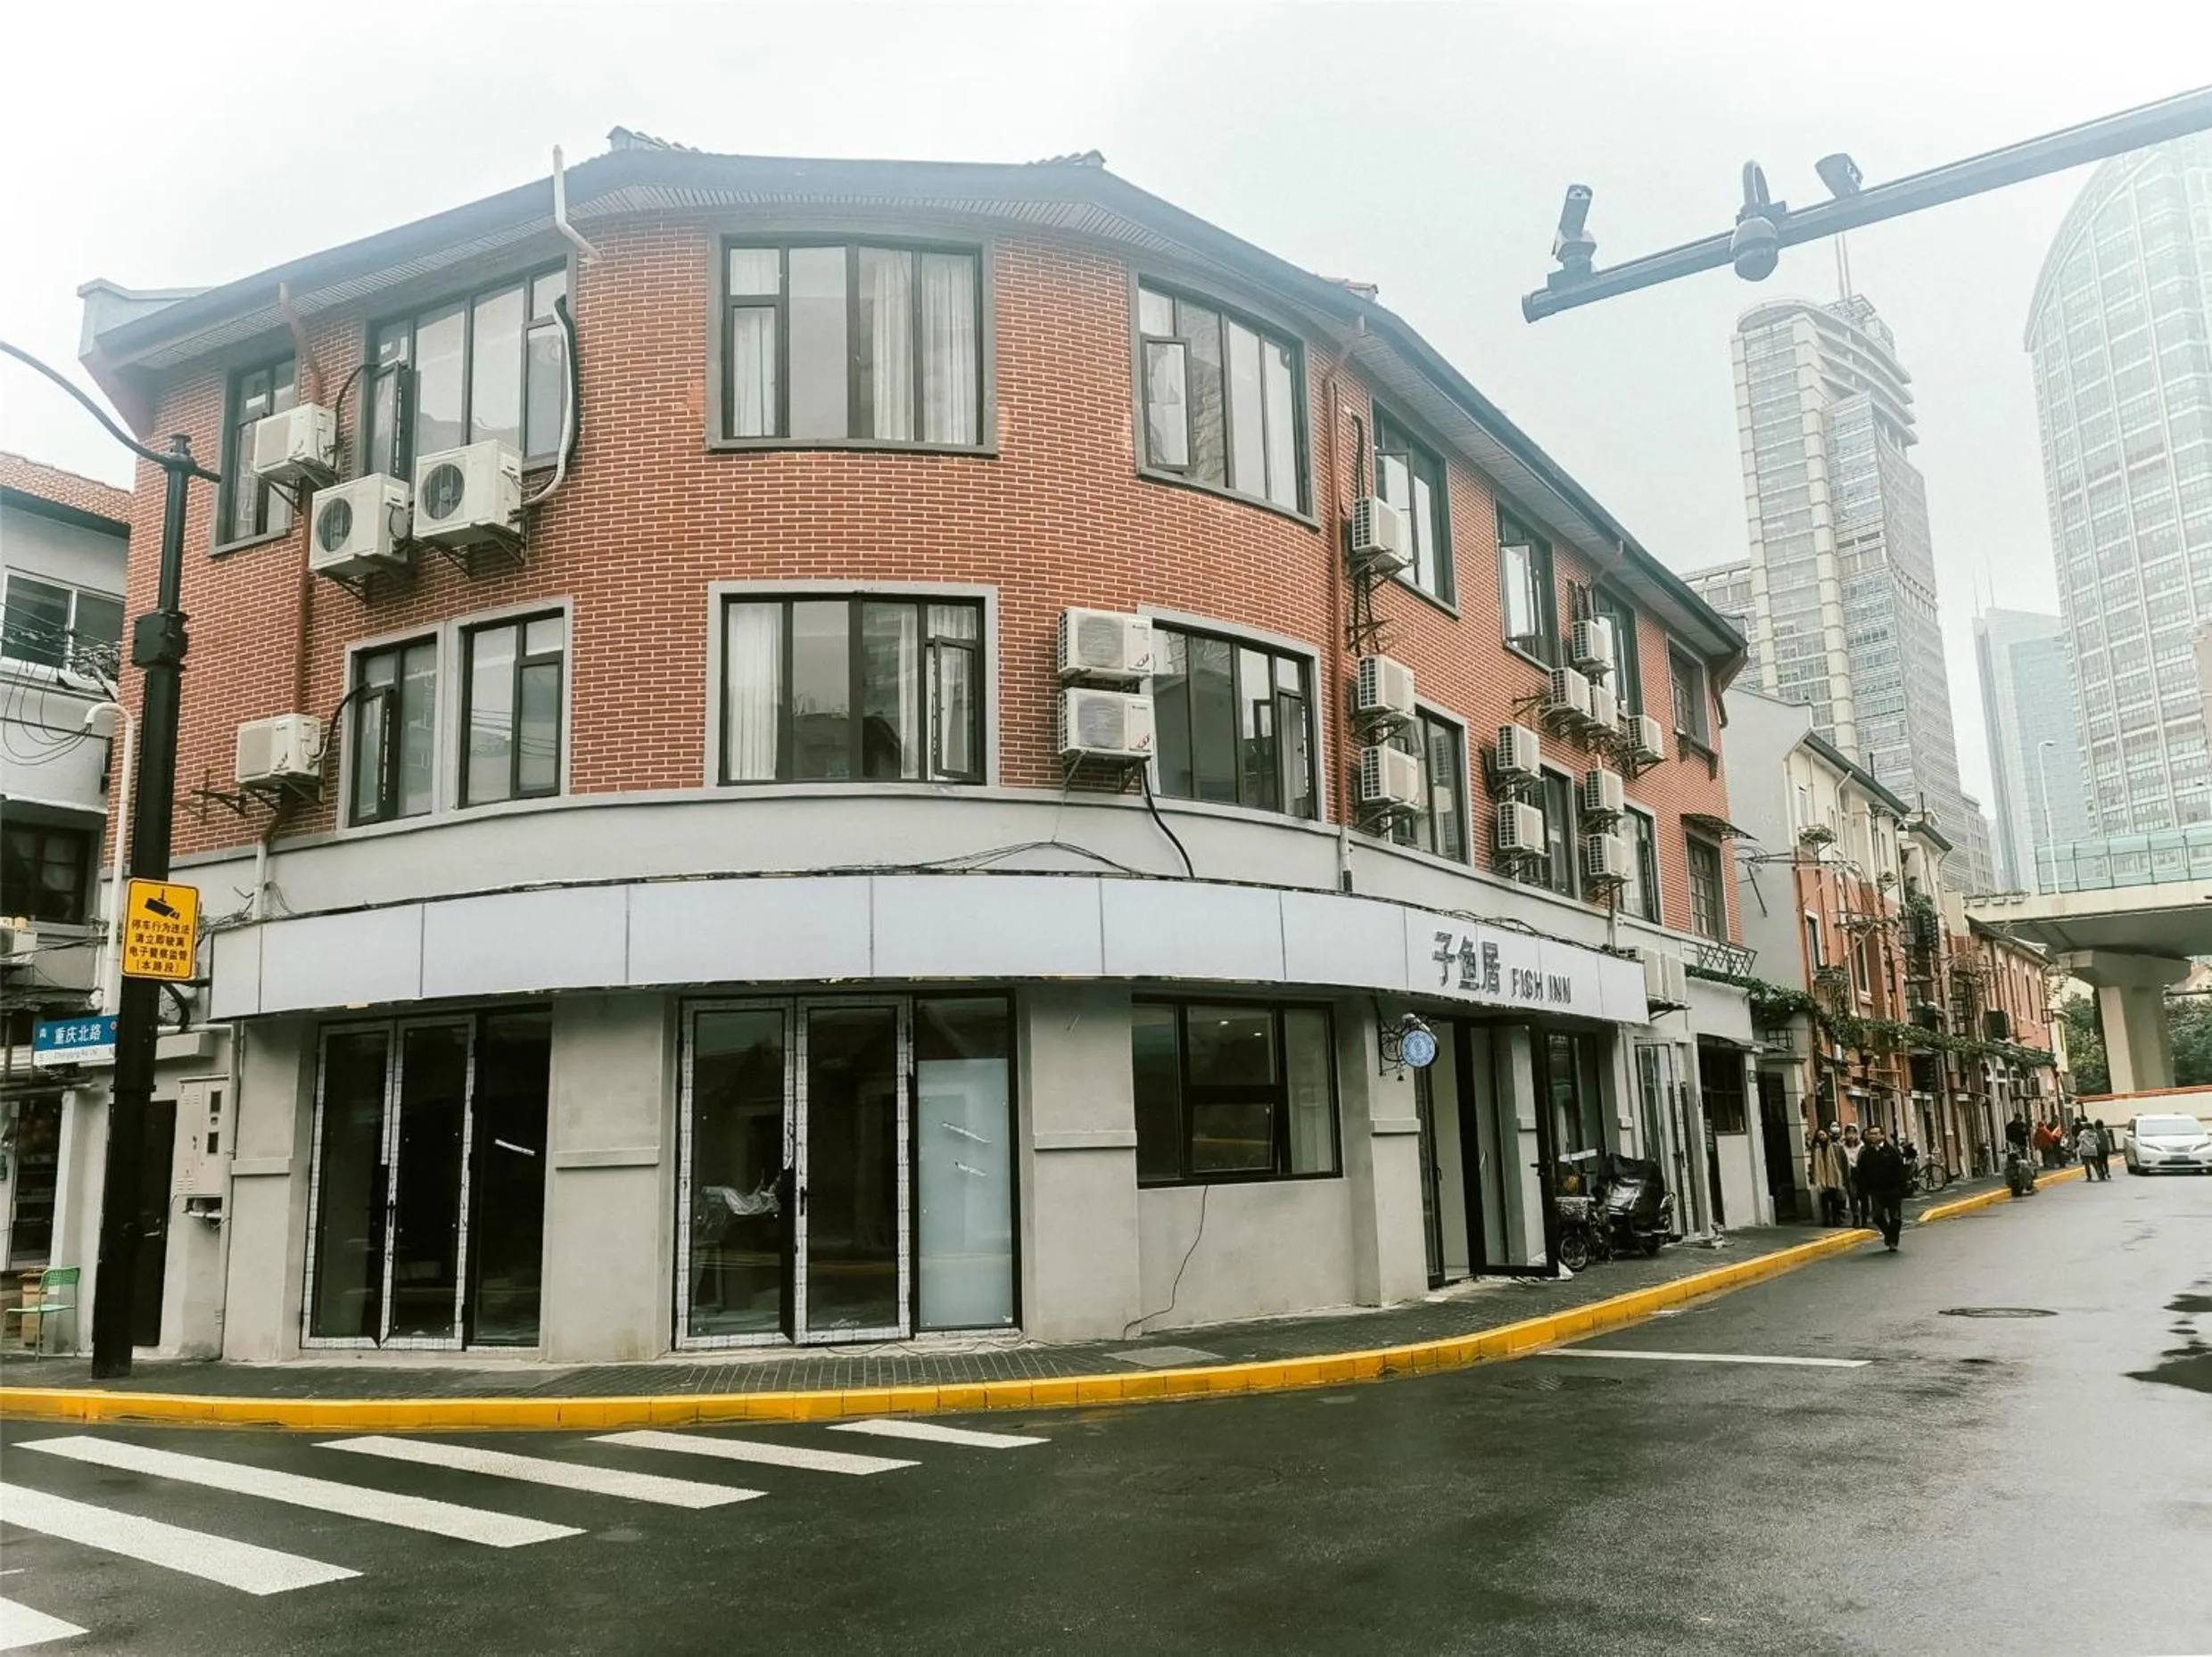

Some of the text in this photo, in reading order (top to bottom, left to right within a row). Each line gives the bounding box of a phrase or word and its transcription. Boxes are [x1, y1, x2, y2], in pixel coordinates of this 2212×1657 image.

[1432, 930, 1501, 995] 子鱼居
[1511, 968, 1572, 1005] FISH INN
[54, 1023, 102, 1044] 重庆北路
